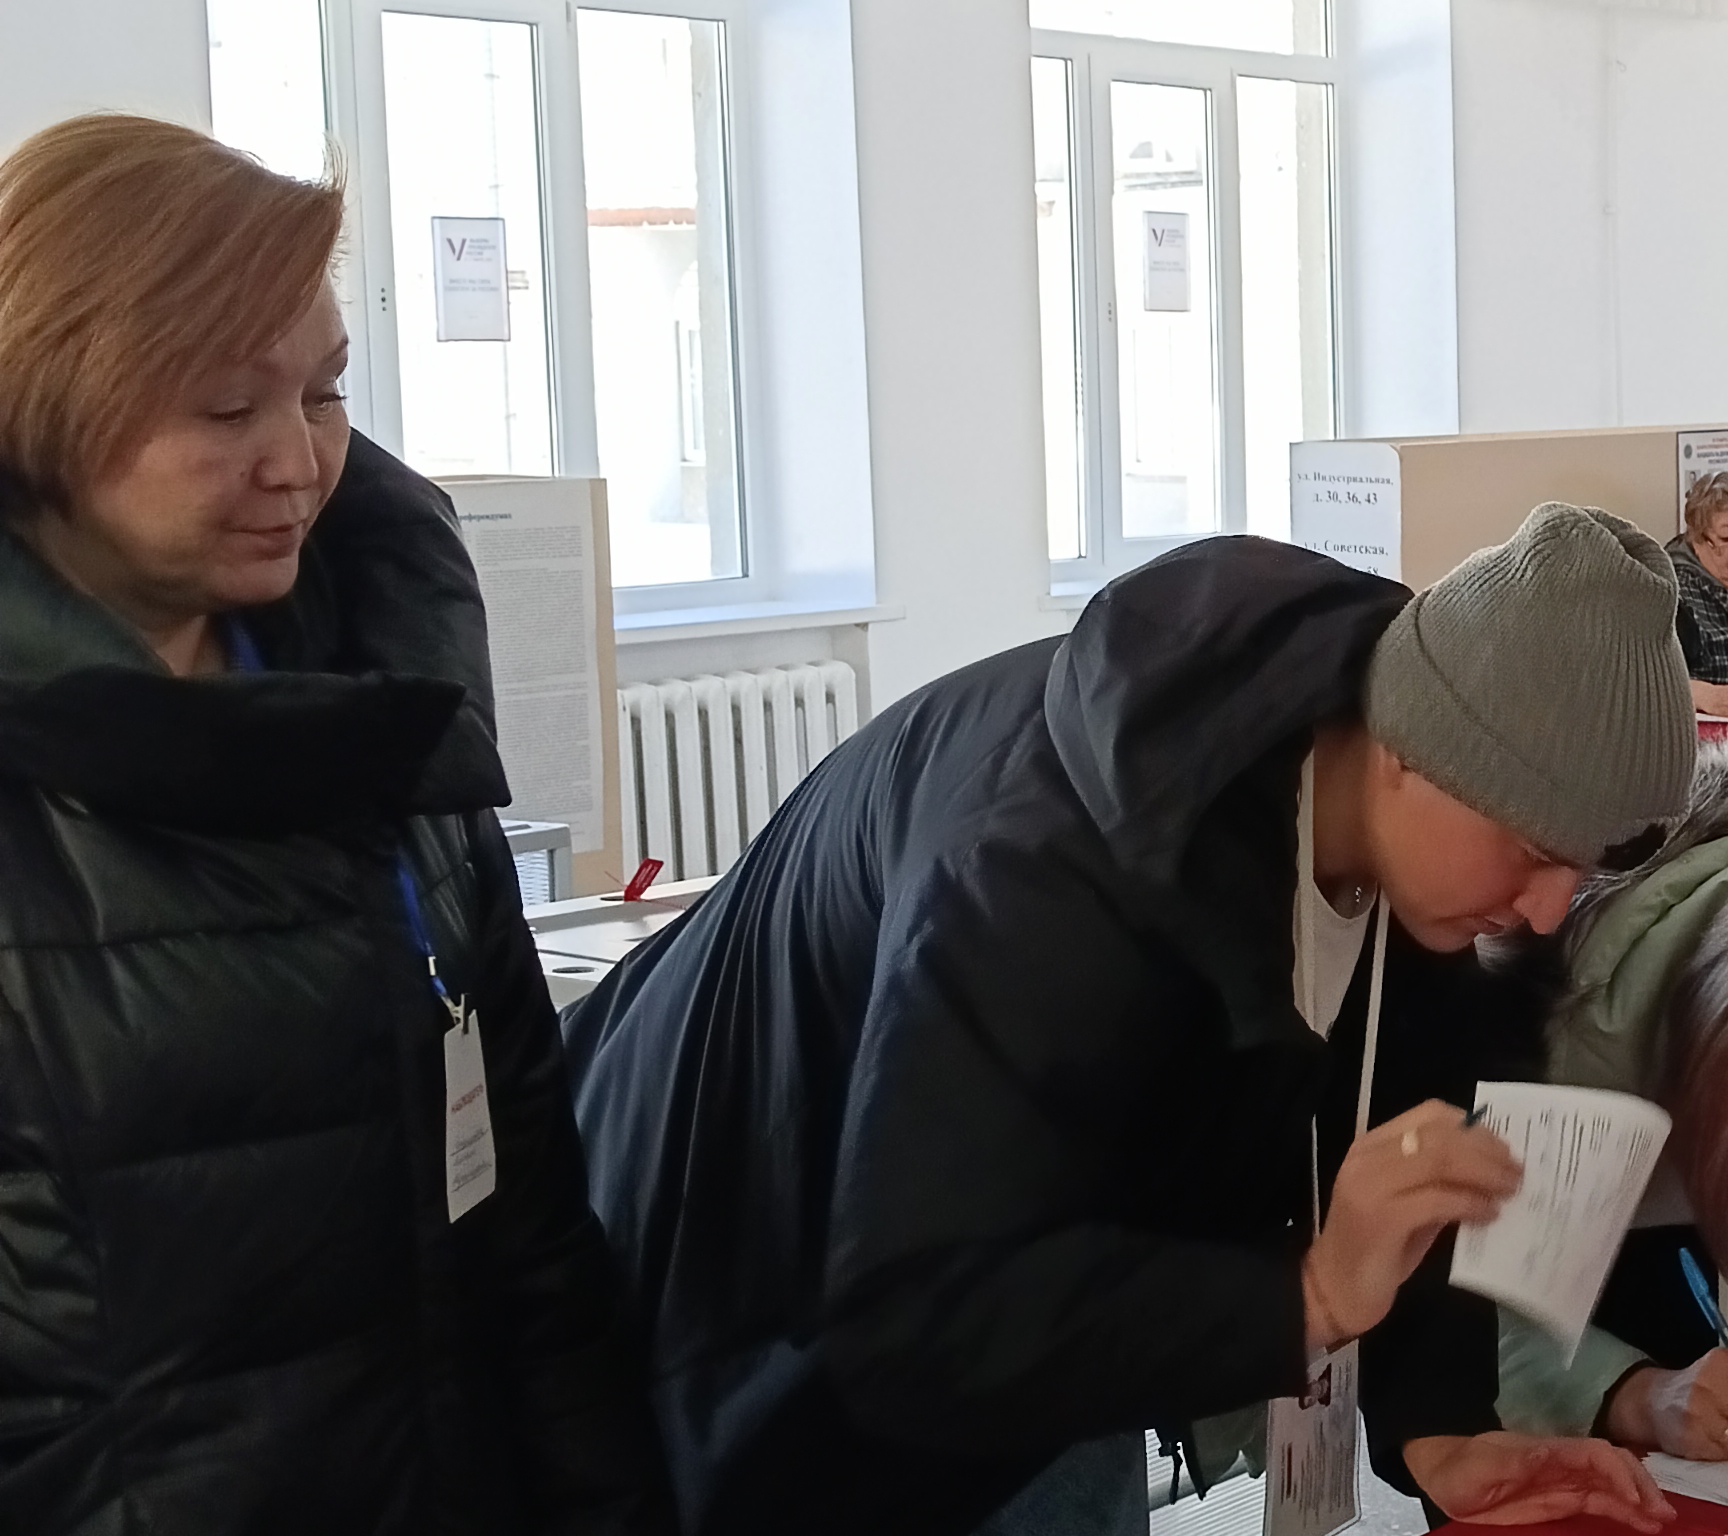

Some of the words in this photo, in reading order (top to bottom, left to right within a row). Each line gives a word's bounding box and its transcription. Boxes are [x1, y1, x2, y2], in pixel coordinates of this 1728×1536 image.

[1313, 472, 1394, 486] Индустриальная,
[1326, 491, 1342, 504] 30,
[1345, 492, 1362, 505] 36,
[1365, 492, 1378, 505] 43
[1324, 539, 1389, 556] Советская,
